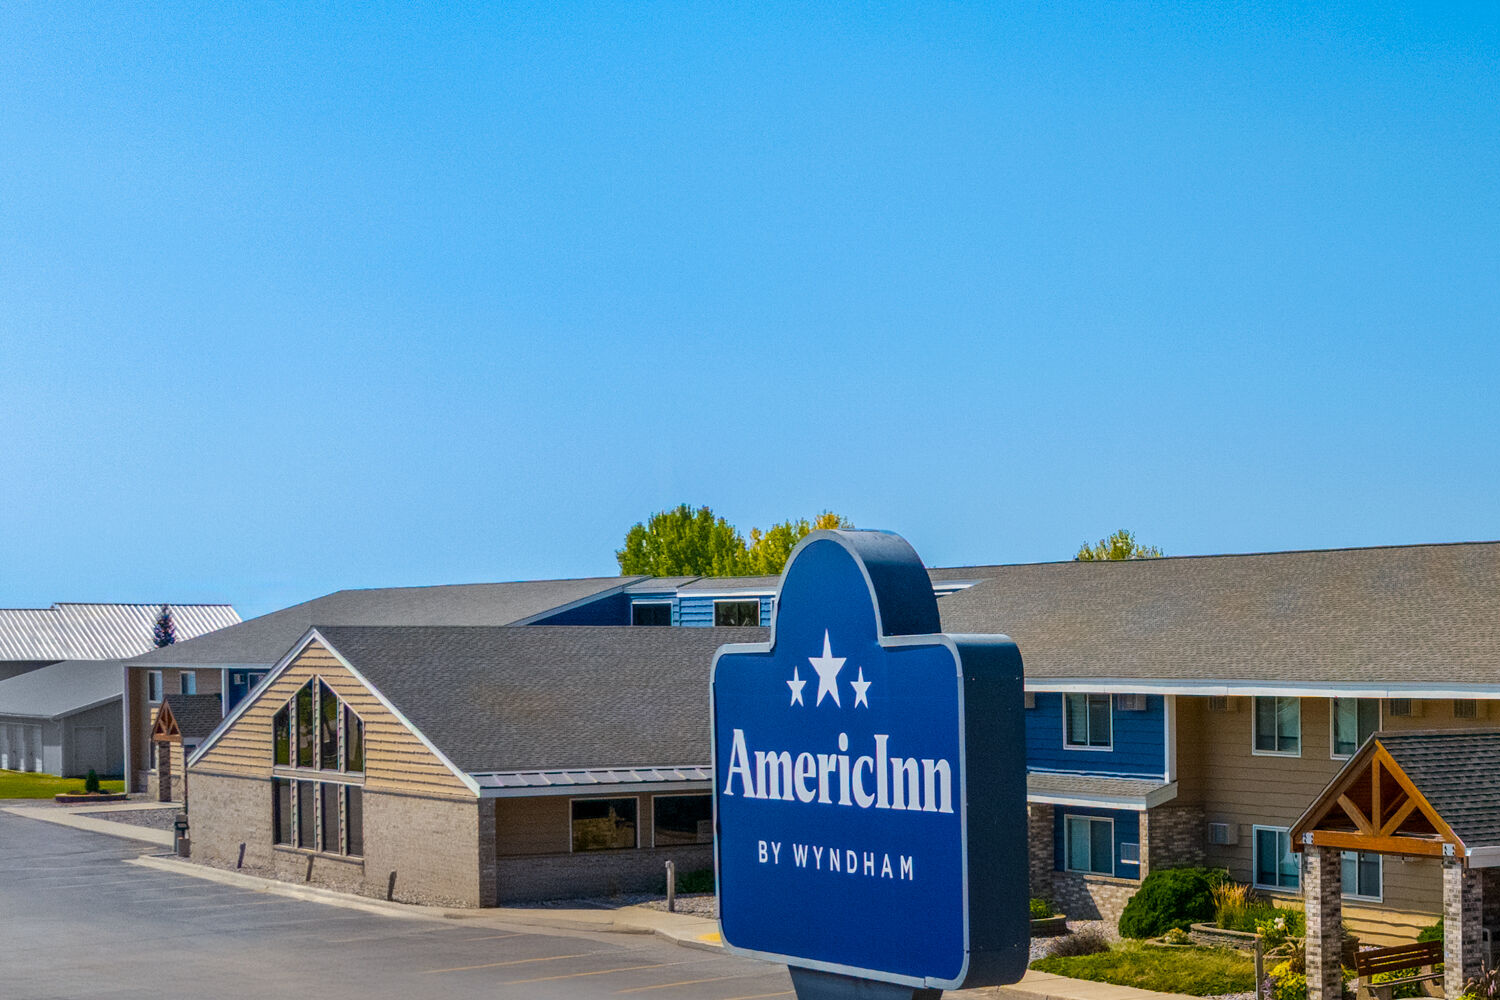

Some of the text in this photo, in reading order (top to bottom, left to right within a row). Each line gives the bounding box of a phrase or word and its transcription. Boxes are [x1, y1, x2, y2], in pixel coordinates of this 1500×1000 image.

[723, 729, 954, 814] AmericInn
[758, 840, 913, 881] BY WYNDHAM
